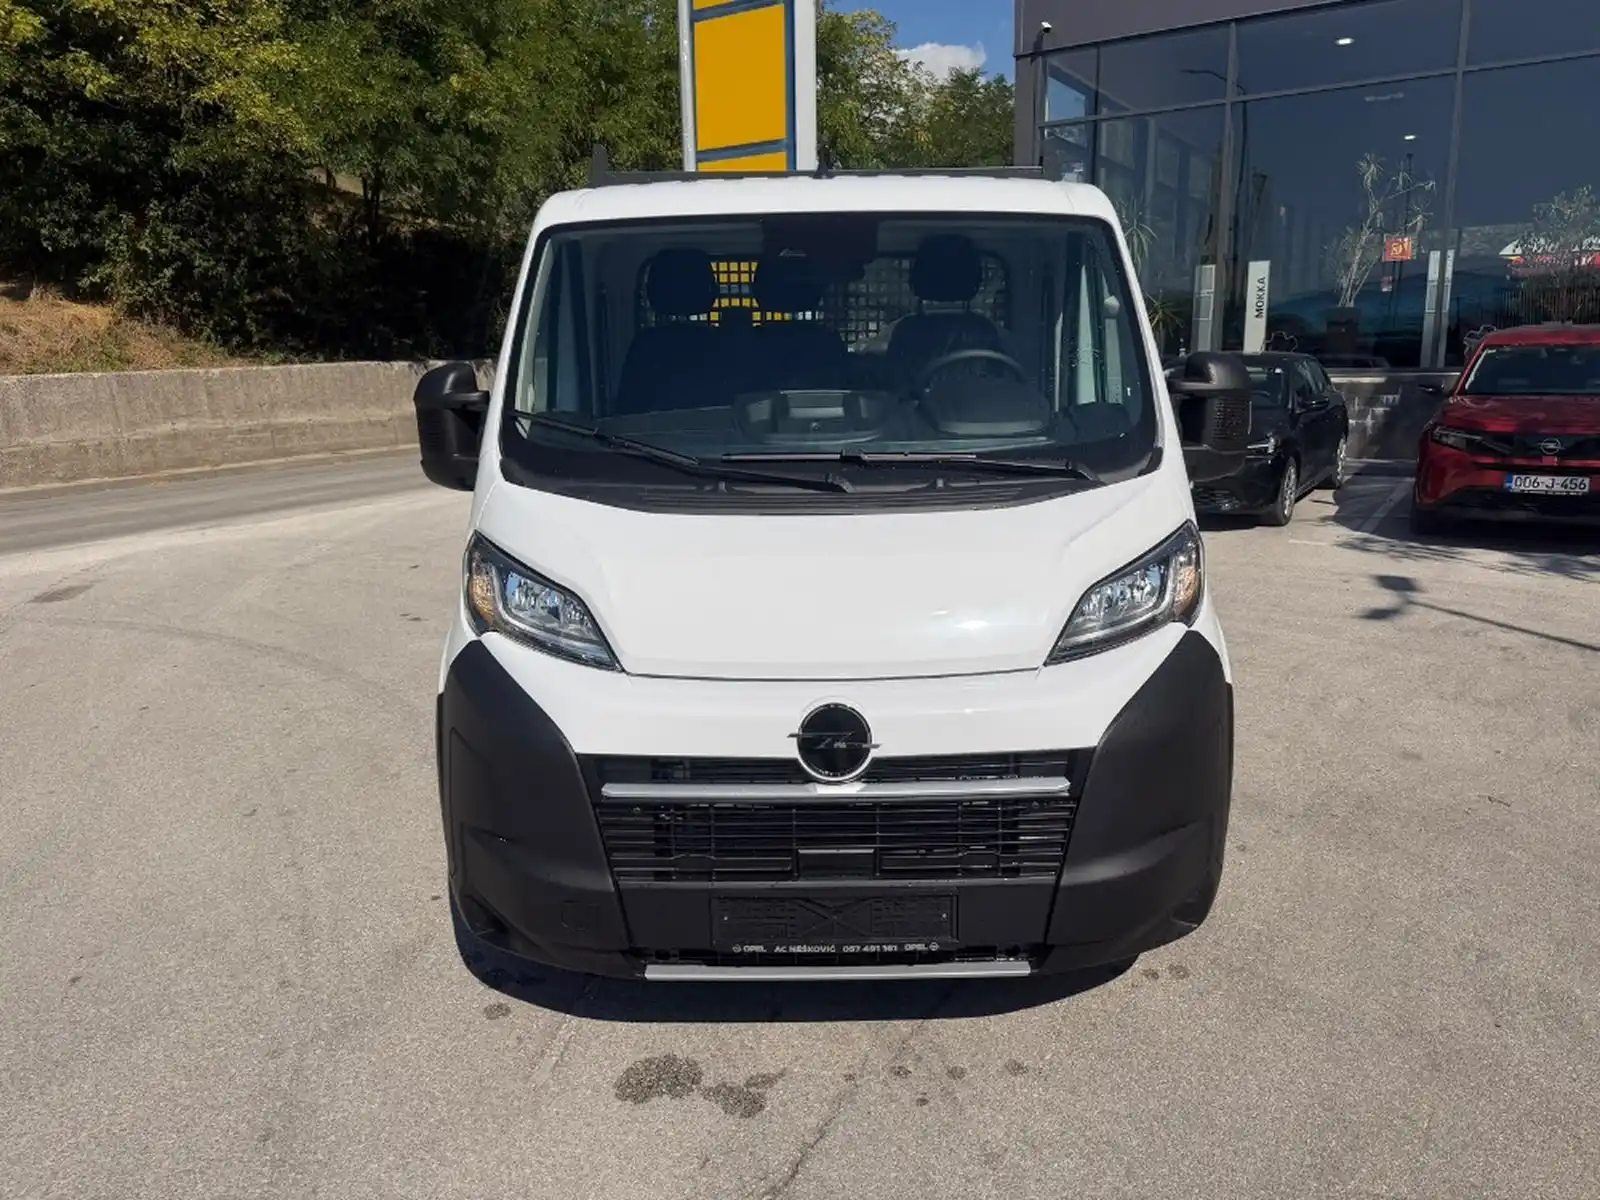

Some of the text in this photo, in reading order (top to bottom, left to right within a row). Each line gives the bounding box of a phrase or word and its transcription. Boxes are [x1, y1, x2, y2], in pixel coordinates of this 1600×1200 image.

[1254, 276, 1266, 319] MOKKA
[743, 944, 767, 953] OPEL
[904, 942, 929, 951] OPEL
